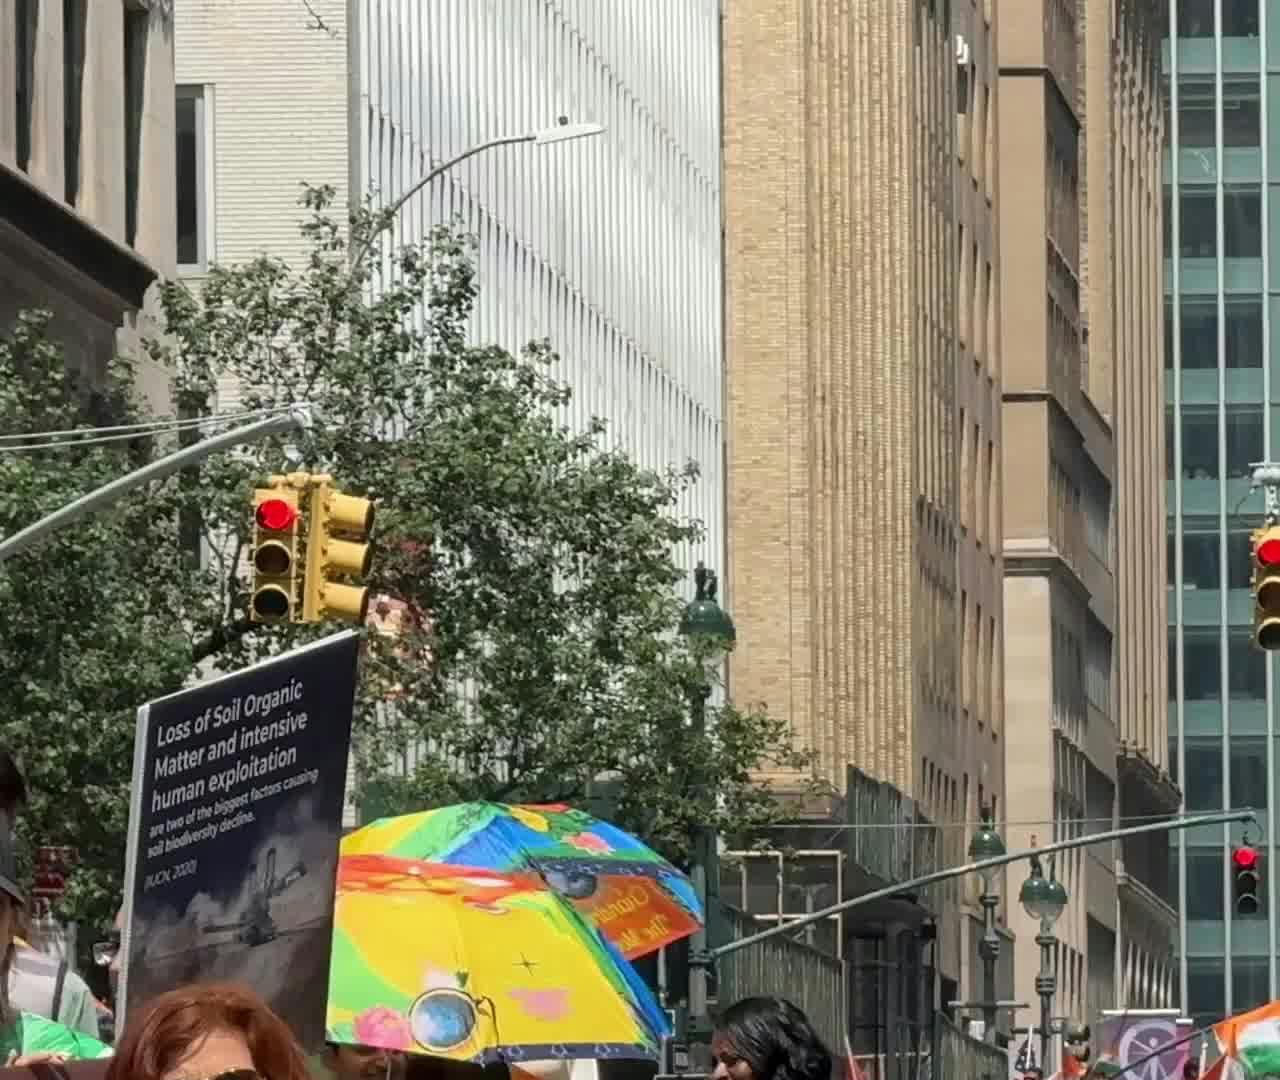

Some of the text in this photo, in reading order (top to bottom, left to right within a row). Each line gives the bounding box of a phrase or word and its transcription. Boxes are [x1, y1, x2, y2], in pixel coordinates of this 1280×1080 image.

[154, 710, 309, 780] Matter and intensive
[157, 679, 304, 747] Loss of Soil Organic
[151, 745, 297, 813] human exploitation
[166, 815, 185, 834] two
[185, 807, 197, 828] of
[196, 805, 213, 823] the
[213, 791, 250, 818] biggest
[250, 782, 282, 803] factors
[281, 767, 320, 787] causing
[147, 839, 166, 858] soil
[166, 825, 219, 853] biodiversity
